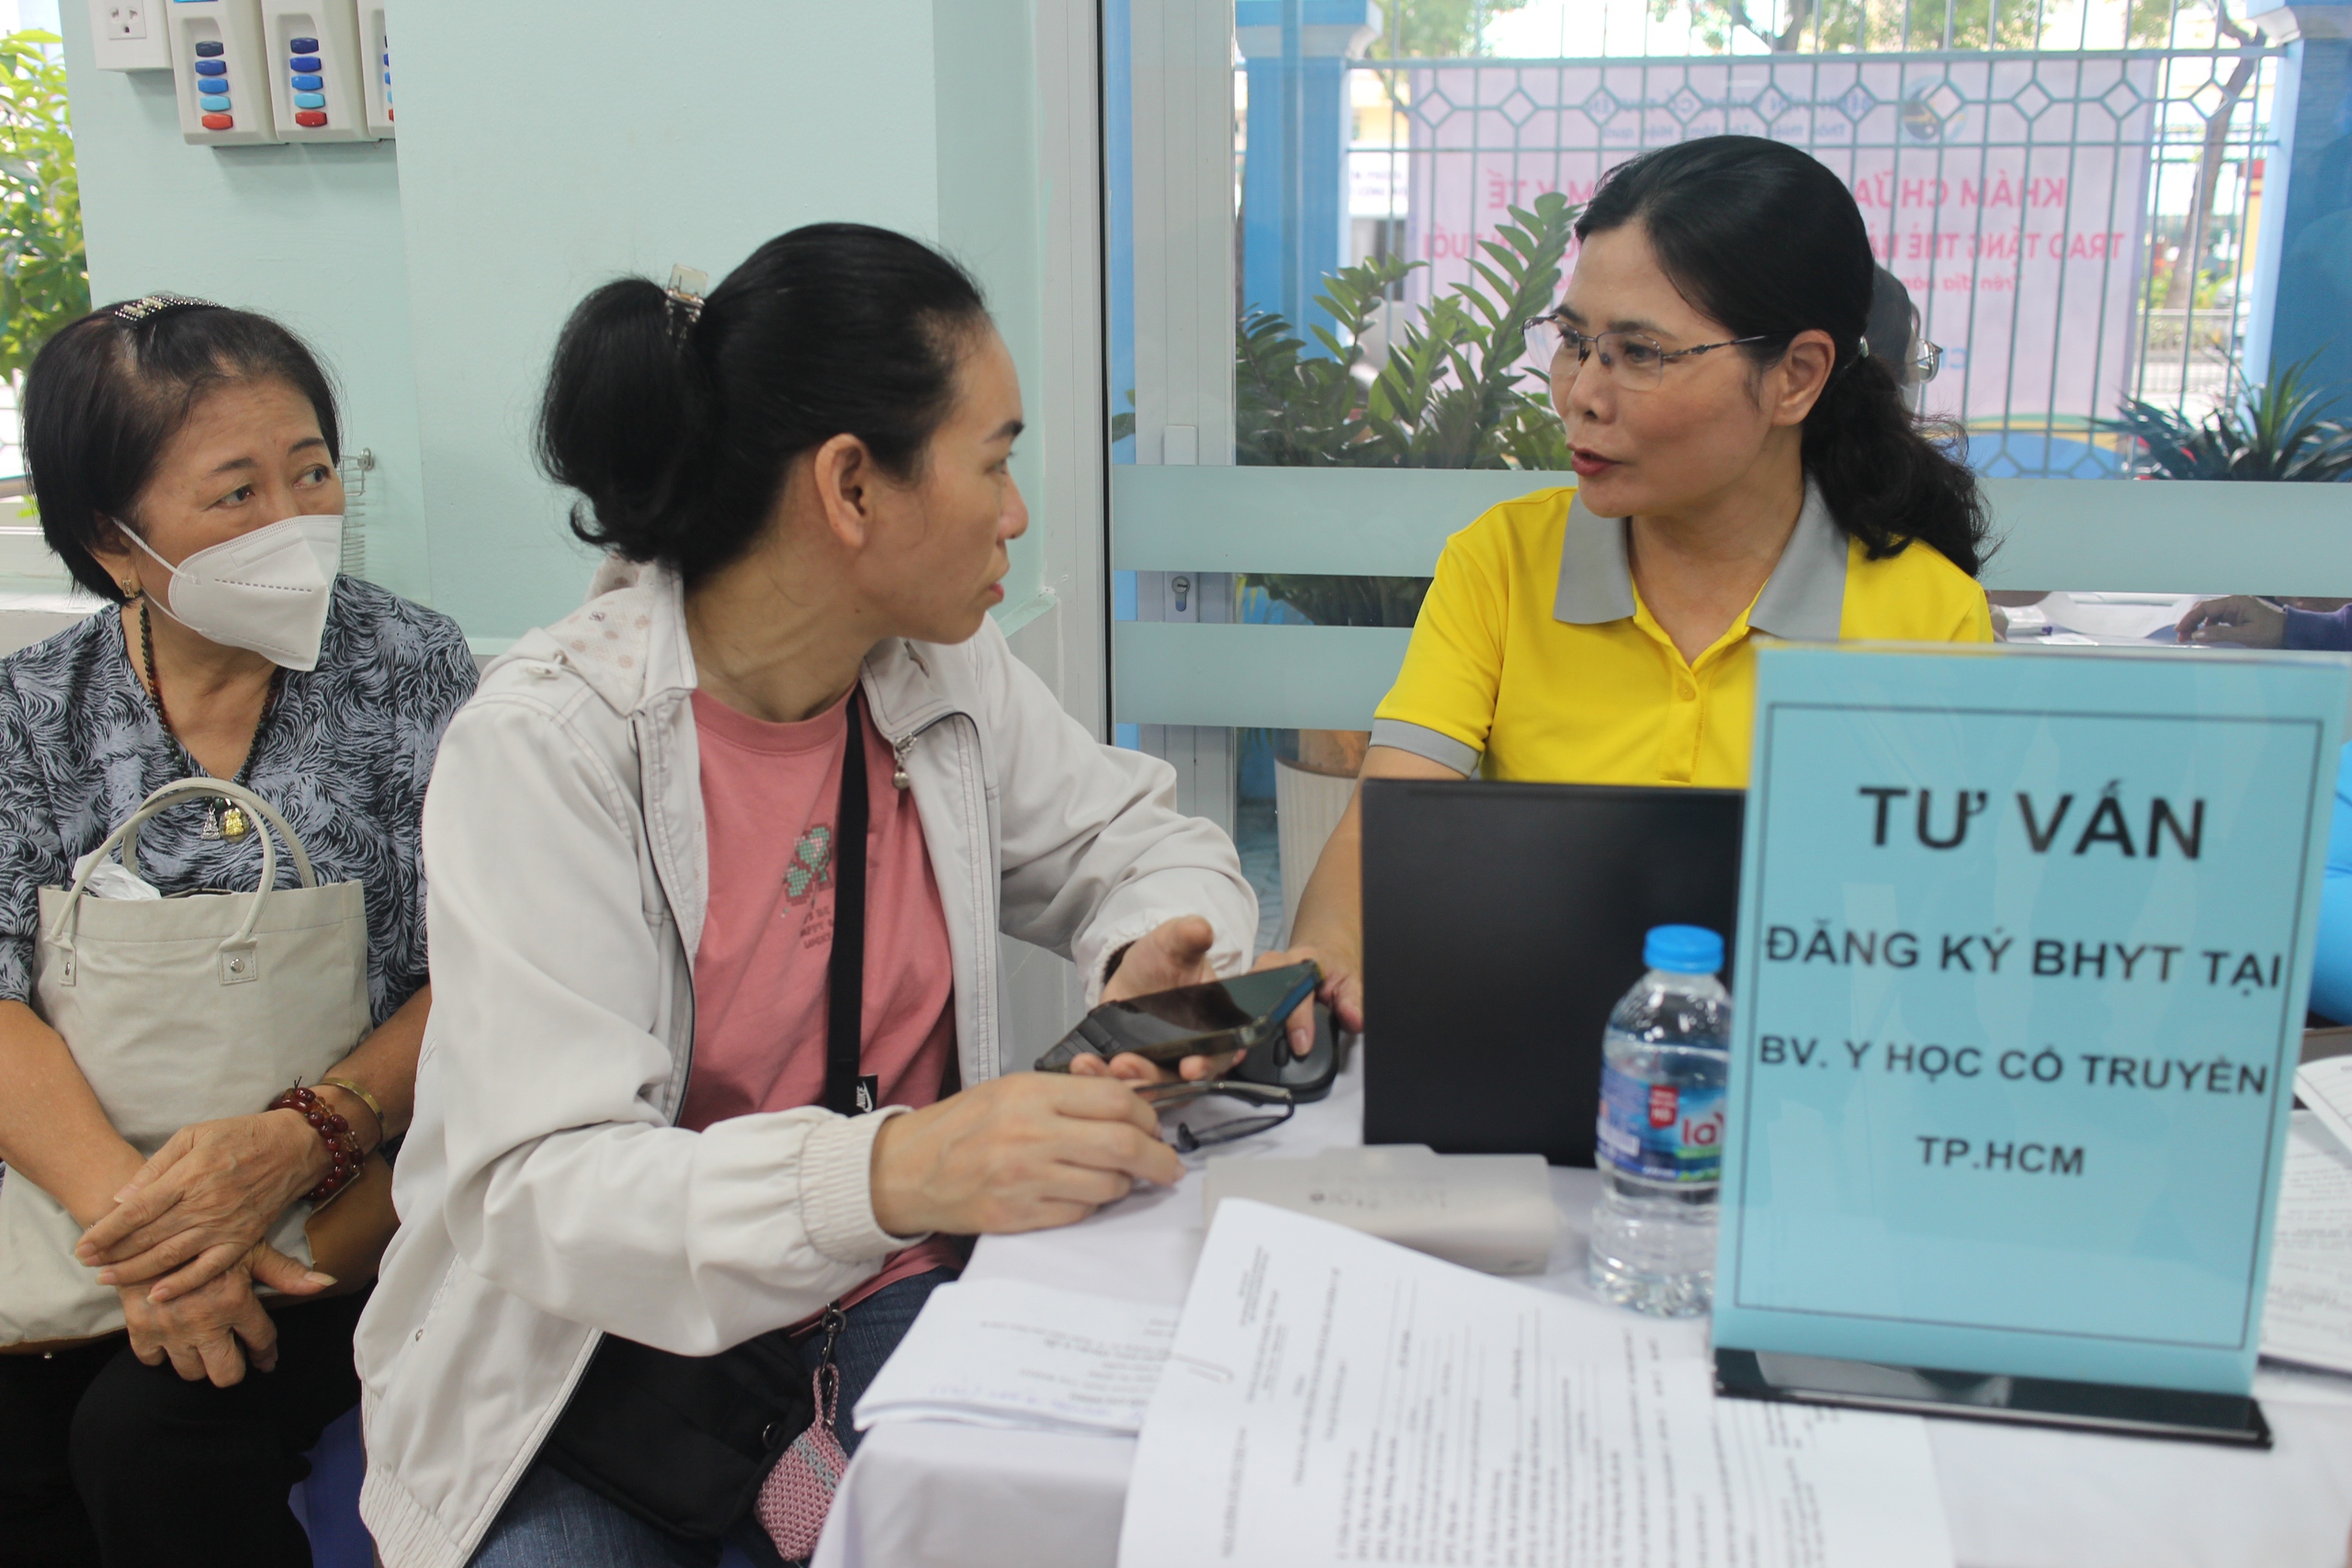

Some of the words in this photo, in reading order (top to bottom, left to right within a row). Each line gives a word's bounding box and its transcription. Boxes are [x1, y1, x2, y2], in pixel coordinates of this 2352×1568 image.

[1859, 786, 1988, 851] TƯ
[2014, 779, 2207, 861] VẤN
[1766, 918, 1919, 969] ĐĂNG
[2031, 939, 2183, 983] BHYT
[2201, 950, 2282, 998] TẠI
[1759, 1035, 1827, 1069] BV.
[1844, 1040, 1872, 1071] Y
[1885, 1044, 1982, 1085] HỌC
[1917, 1135, 2085, 1177] TP.HCM
